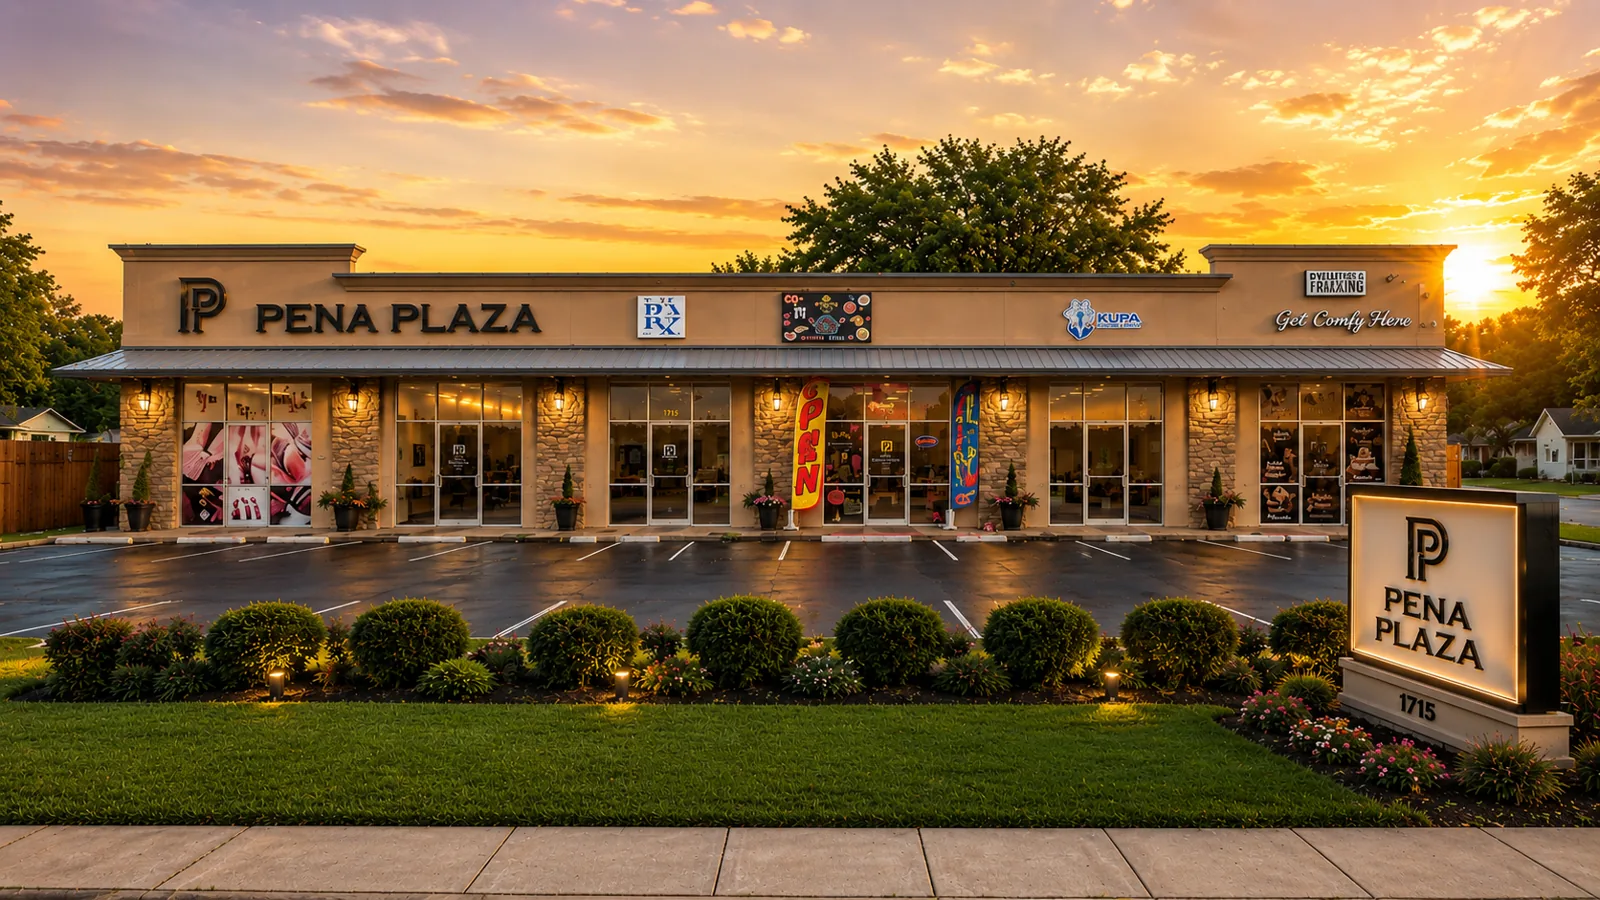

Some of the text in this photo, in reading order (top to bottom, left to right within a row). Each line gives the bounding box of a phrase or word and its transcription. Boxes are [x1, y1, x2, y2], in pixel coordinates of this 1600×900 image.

[256, 304, 542, 334] PENA PLAZA
[1097, 314, 1140, 323] KUPA
[1276, 310, 1412, 333] Get Comfy Here
[663, 409, 679, 417] 1715
[1384, 586, 1472, 630] PENA
[1375, 616, 1484, 670] PLAZA
[1400, 693, 1436, 722] 1715
